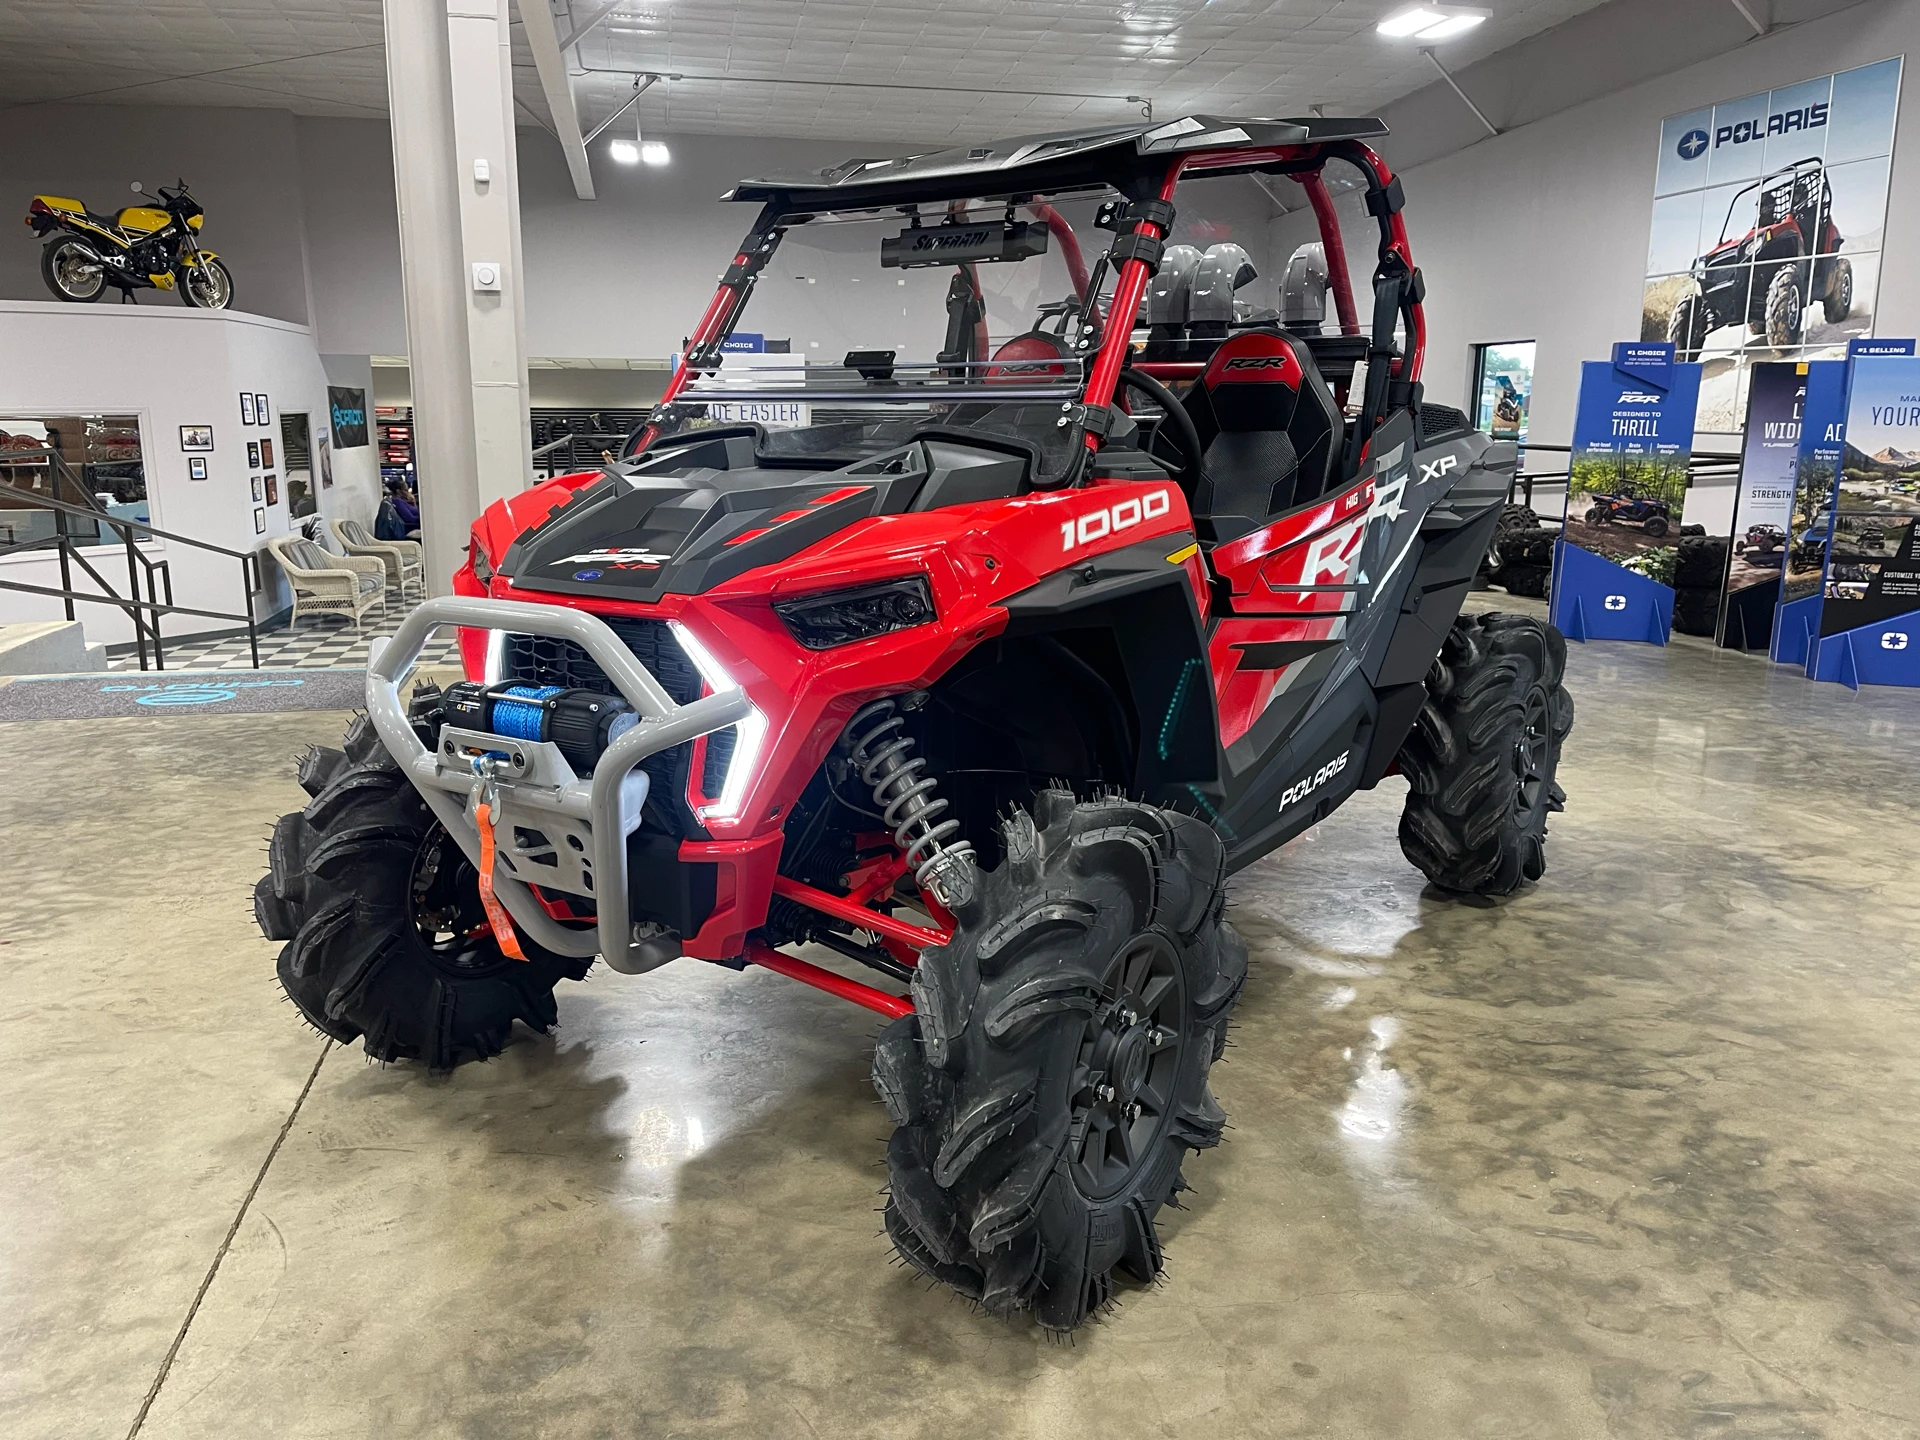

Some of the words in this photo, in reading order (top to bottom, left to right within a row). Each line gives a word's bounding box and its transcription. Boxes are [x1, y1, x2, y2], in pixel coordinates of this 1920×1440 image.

[1715, 102, 1831, 149] POLARIS
[1222, 356, 1287, 372] RZR
[1617, 395, 1661, 404] RZR
[704, 403, 733, 420] ADE
[740, 403, 799, 421] EASIER
[1792, 402, 1805, 420] L
[1612, 419, 1659, 437] THRILL
[1414, 454, 1458, 488] XP
[1751, 489, 1792, 499] STRENGTH
[1060, 488, 1170, 553] 1000
[606, 562, 661, 570] XP
[1883, 571, 1914, 579] CUSTOMIZE
[1278, 749, 1350, 813] POLARIS
